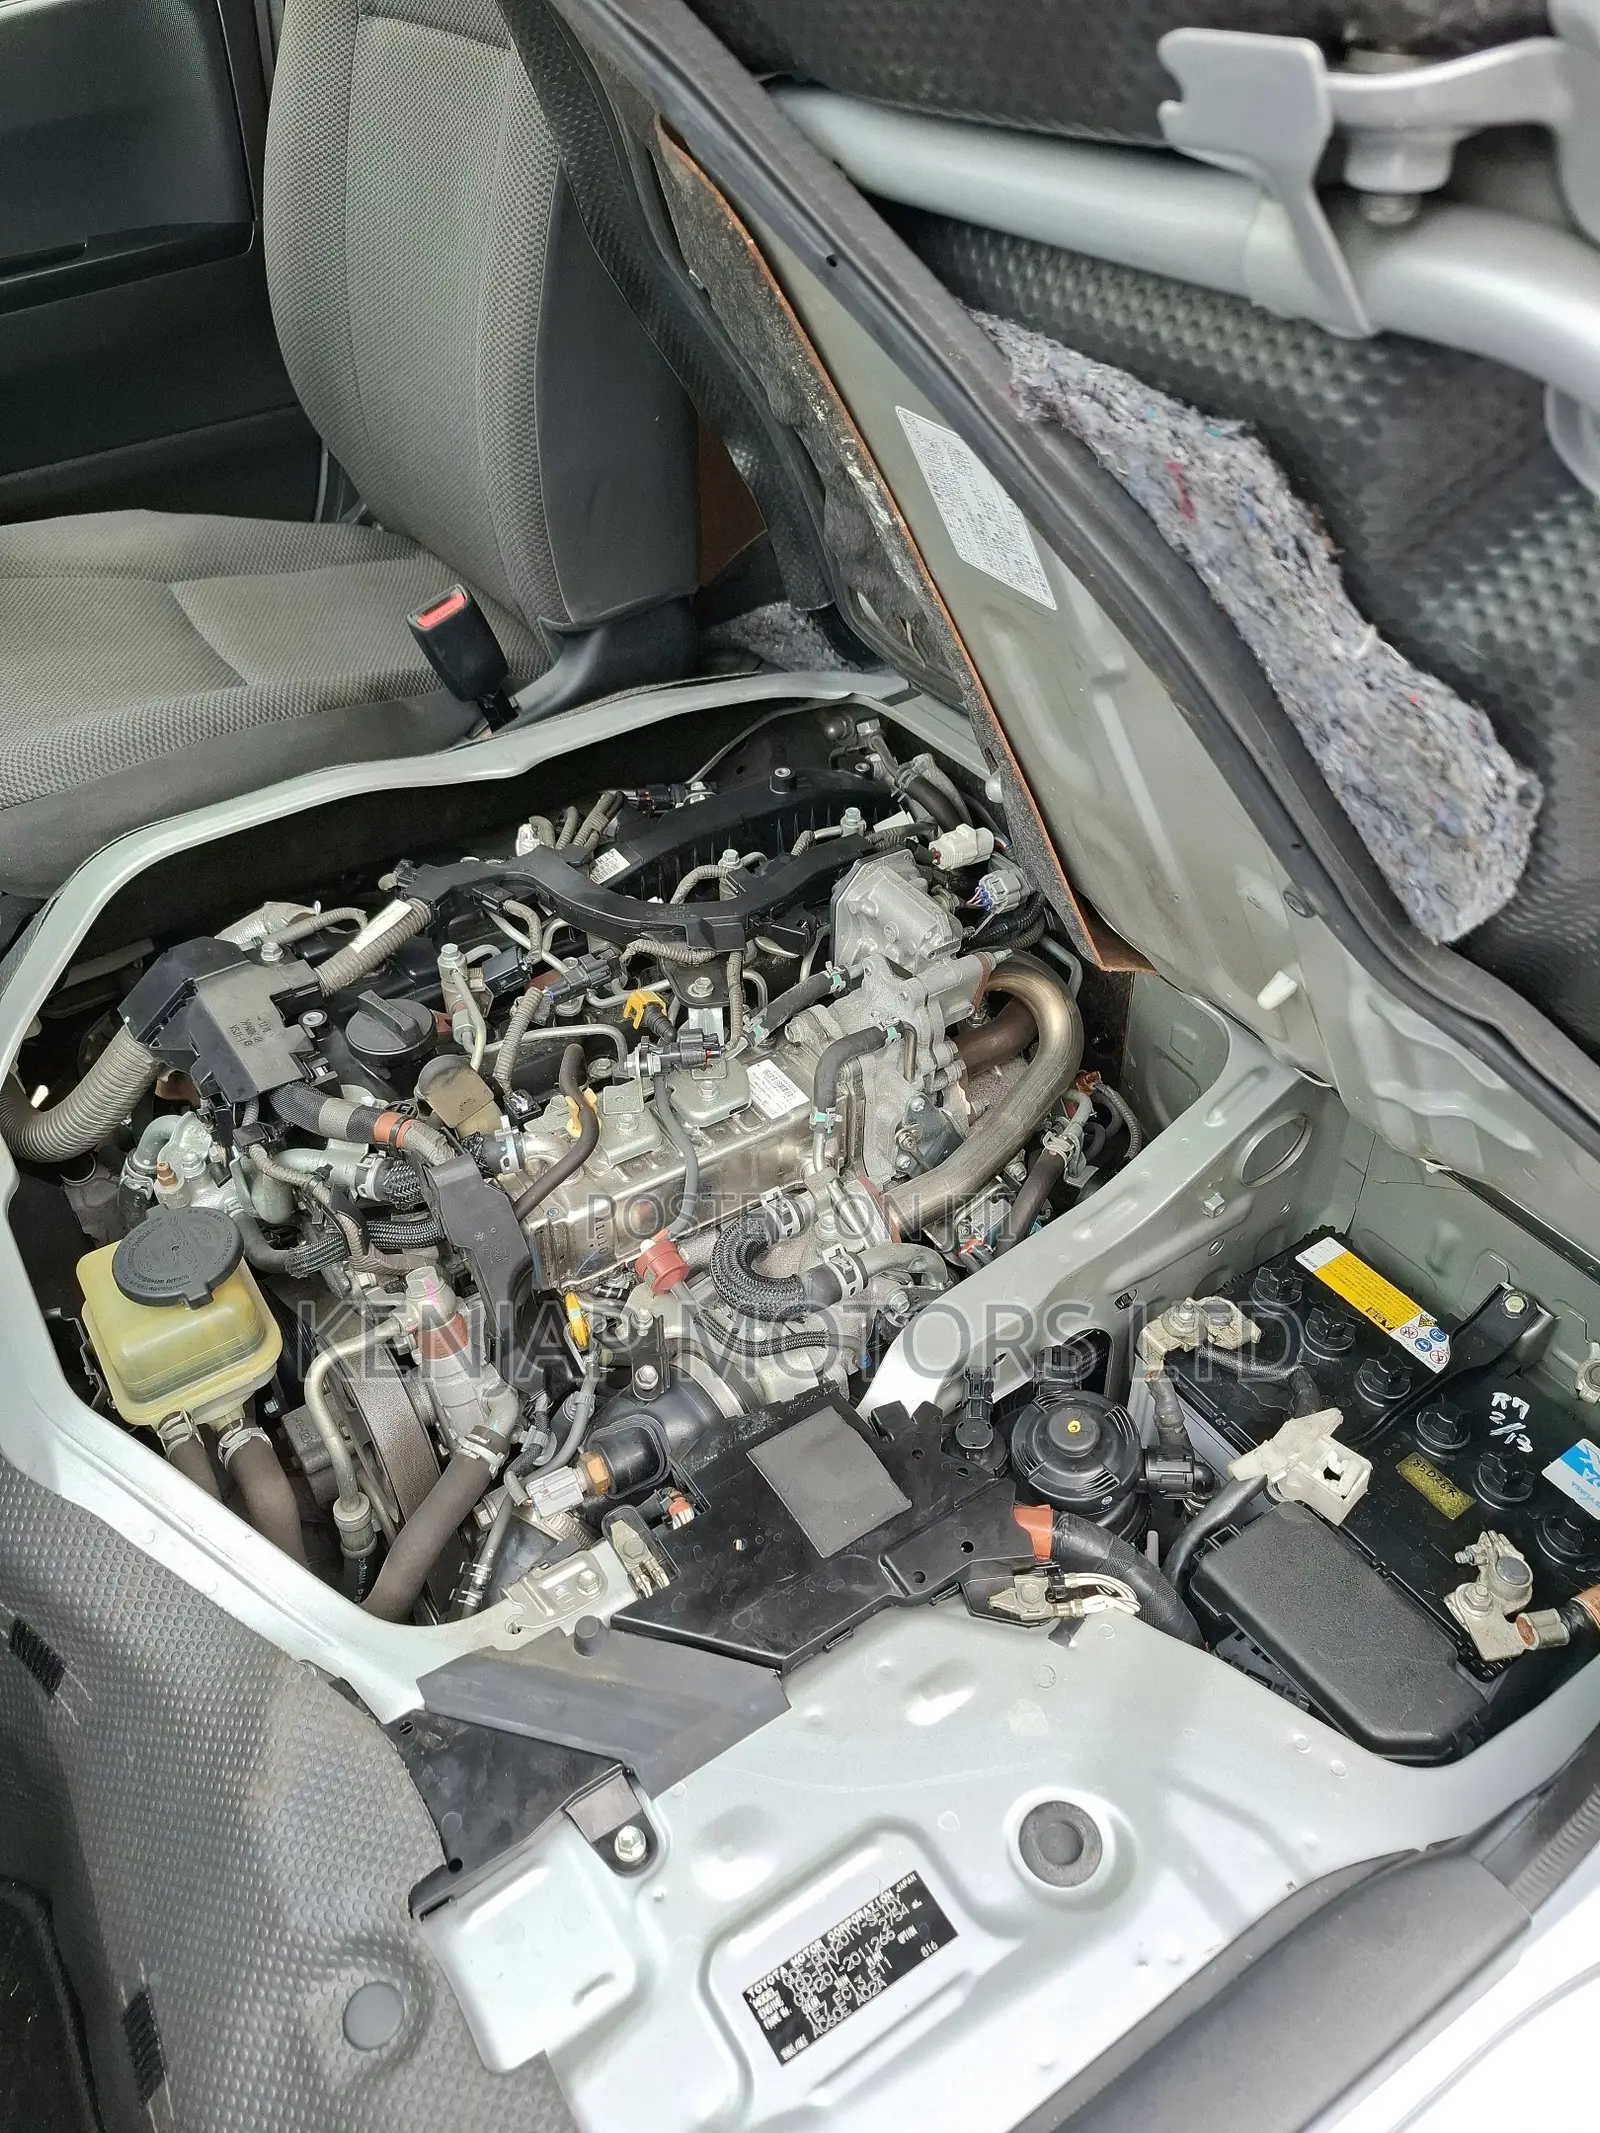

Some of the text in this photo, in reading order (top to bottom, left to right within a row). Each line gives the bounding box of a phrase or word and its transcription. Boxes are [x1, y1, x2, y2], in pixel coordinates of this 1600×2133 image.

[876, 1902, 911, 1933] 2754
[746, 1873, 917, 2000] TOYOTA MOTOR CORPORATION JAPAN
[918, 1938, 939, 1958] 816
